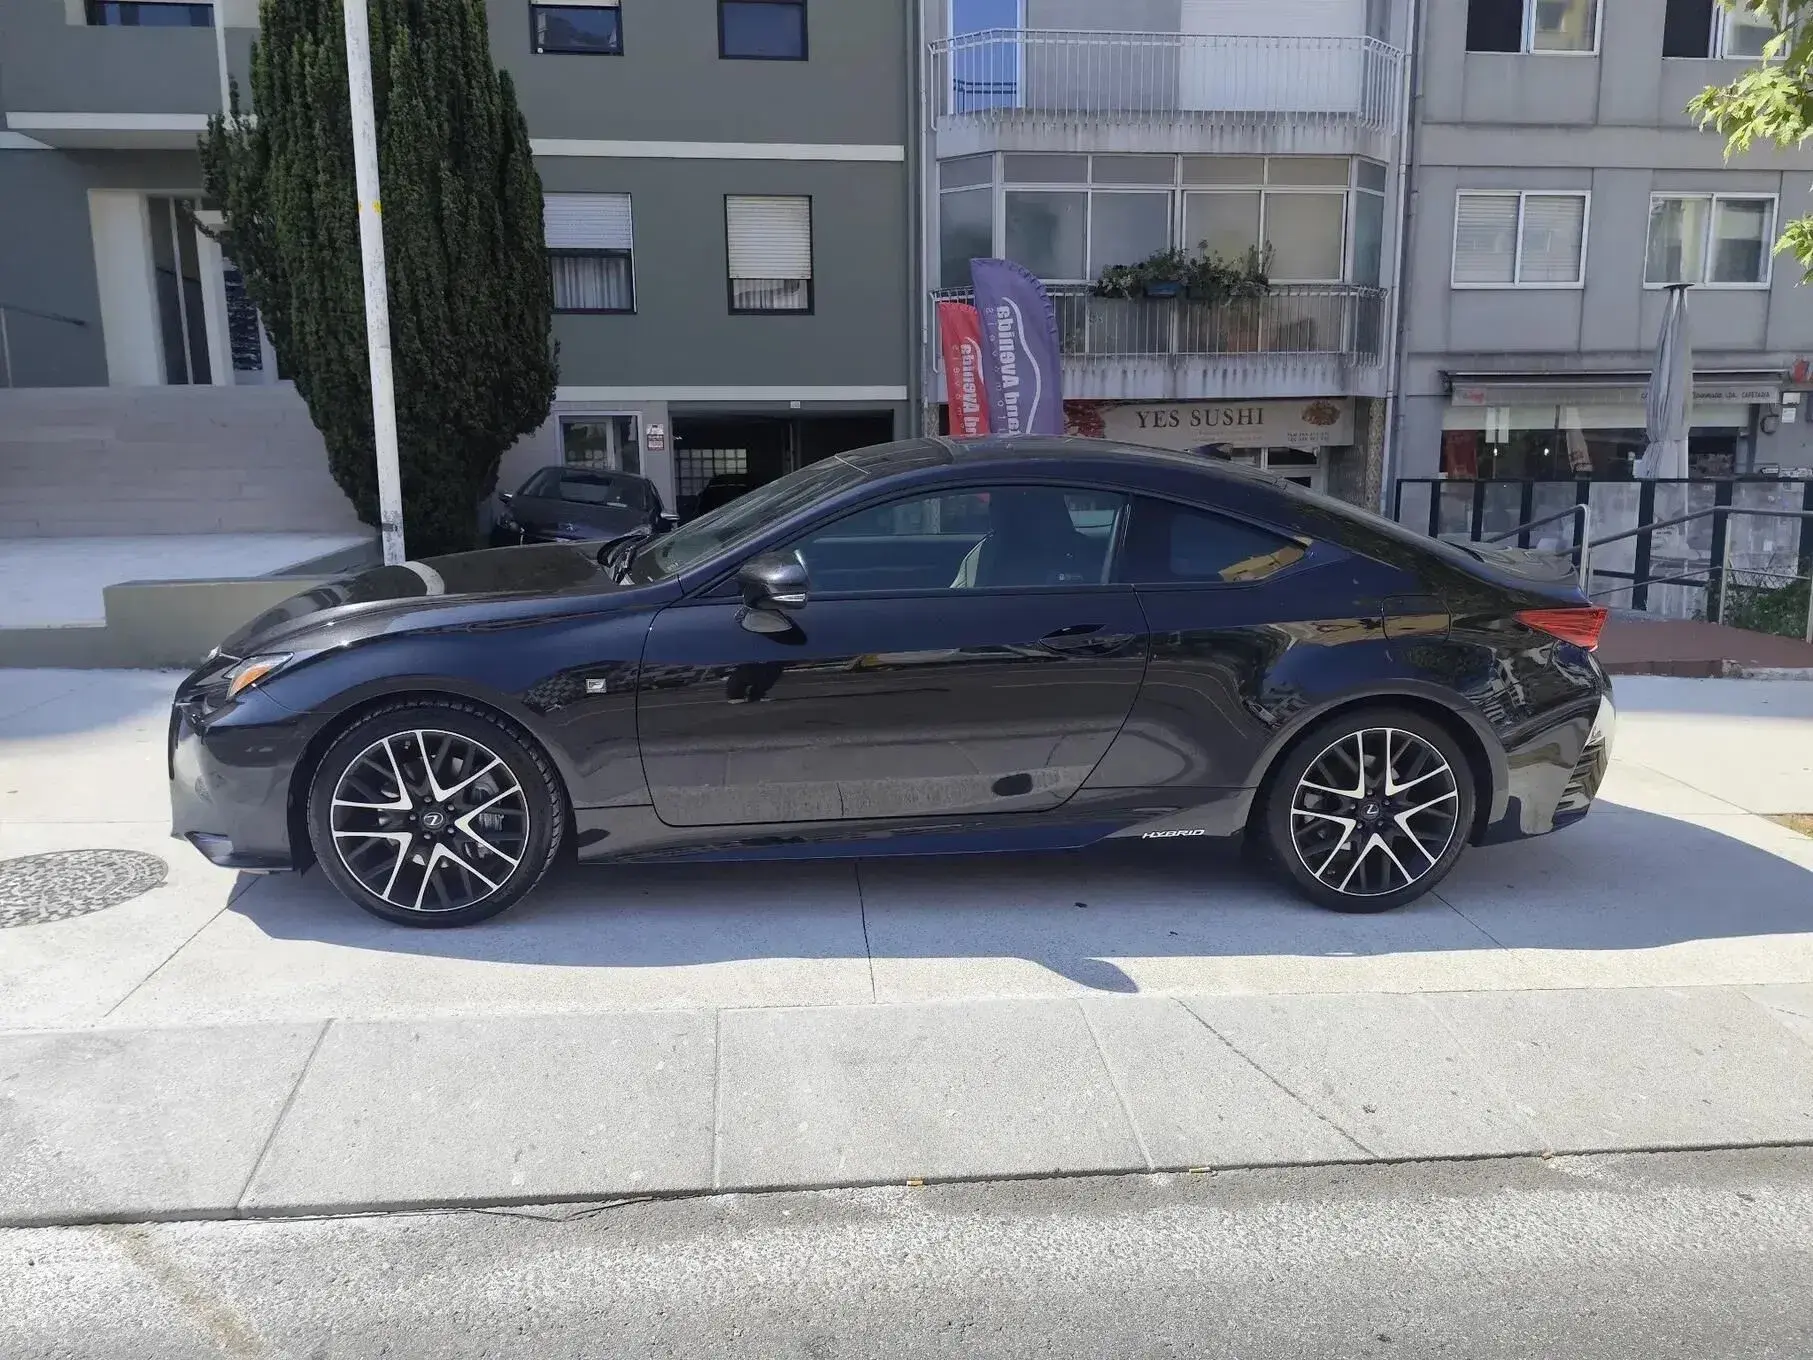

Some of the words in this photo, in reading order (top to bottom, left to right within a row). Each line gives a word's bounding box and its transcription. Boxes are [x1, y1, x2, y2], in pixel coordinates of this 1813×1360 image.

[1135, 408, 1180, 429] YES
[1190, 406, 1265, 428] SUSHI
[1142, 829, 1206, 839] HYBRID
